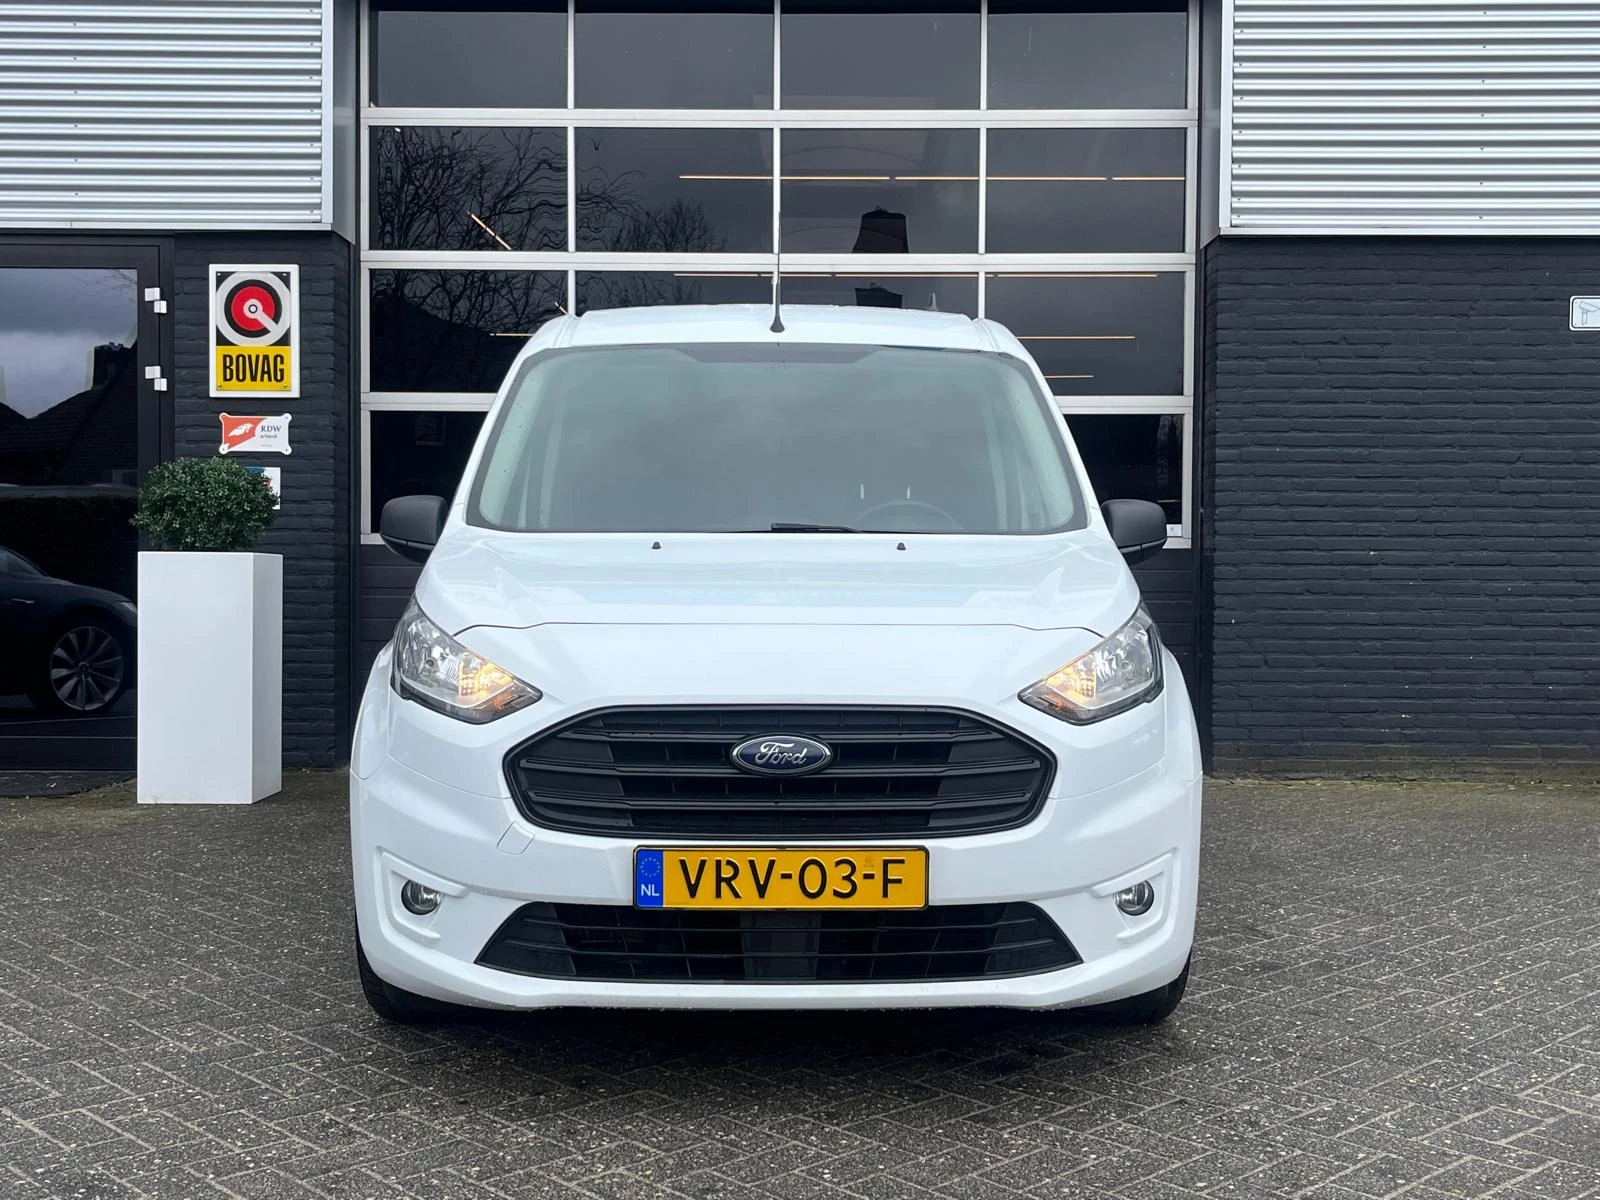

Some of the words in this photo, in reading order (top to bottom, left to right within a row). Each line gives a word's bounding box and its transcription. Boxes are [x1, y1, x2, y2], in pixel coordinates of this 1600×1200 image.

[222, 354, 285, 382] BOVAG
[261, 425, 282, 433] RDW
[755, 742, 808, 765] Ford
[678, 858, 905, 899] VRV-03-F
[641, 884, 660, 897] NL
